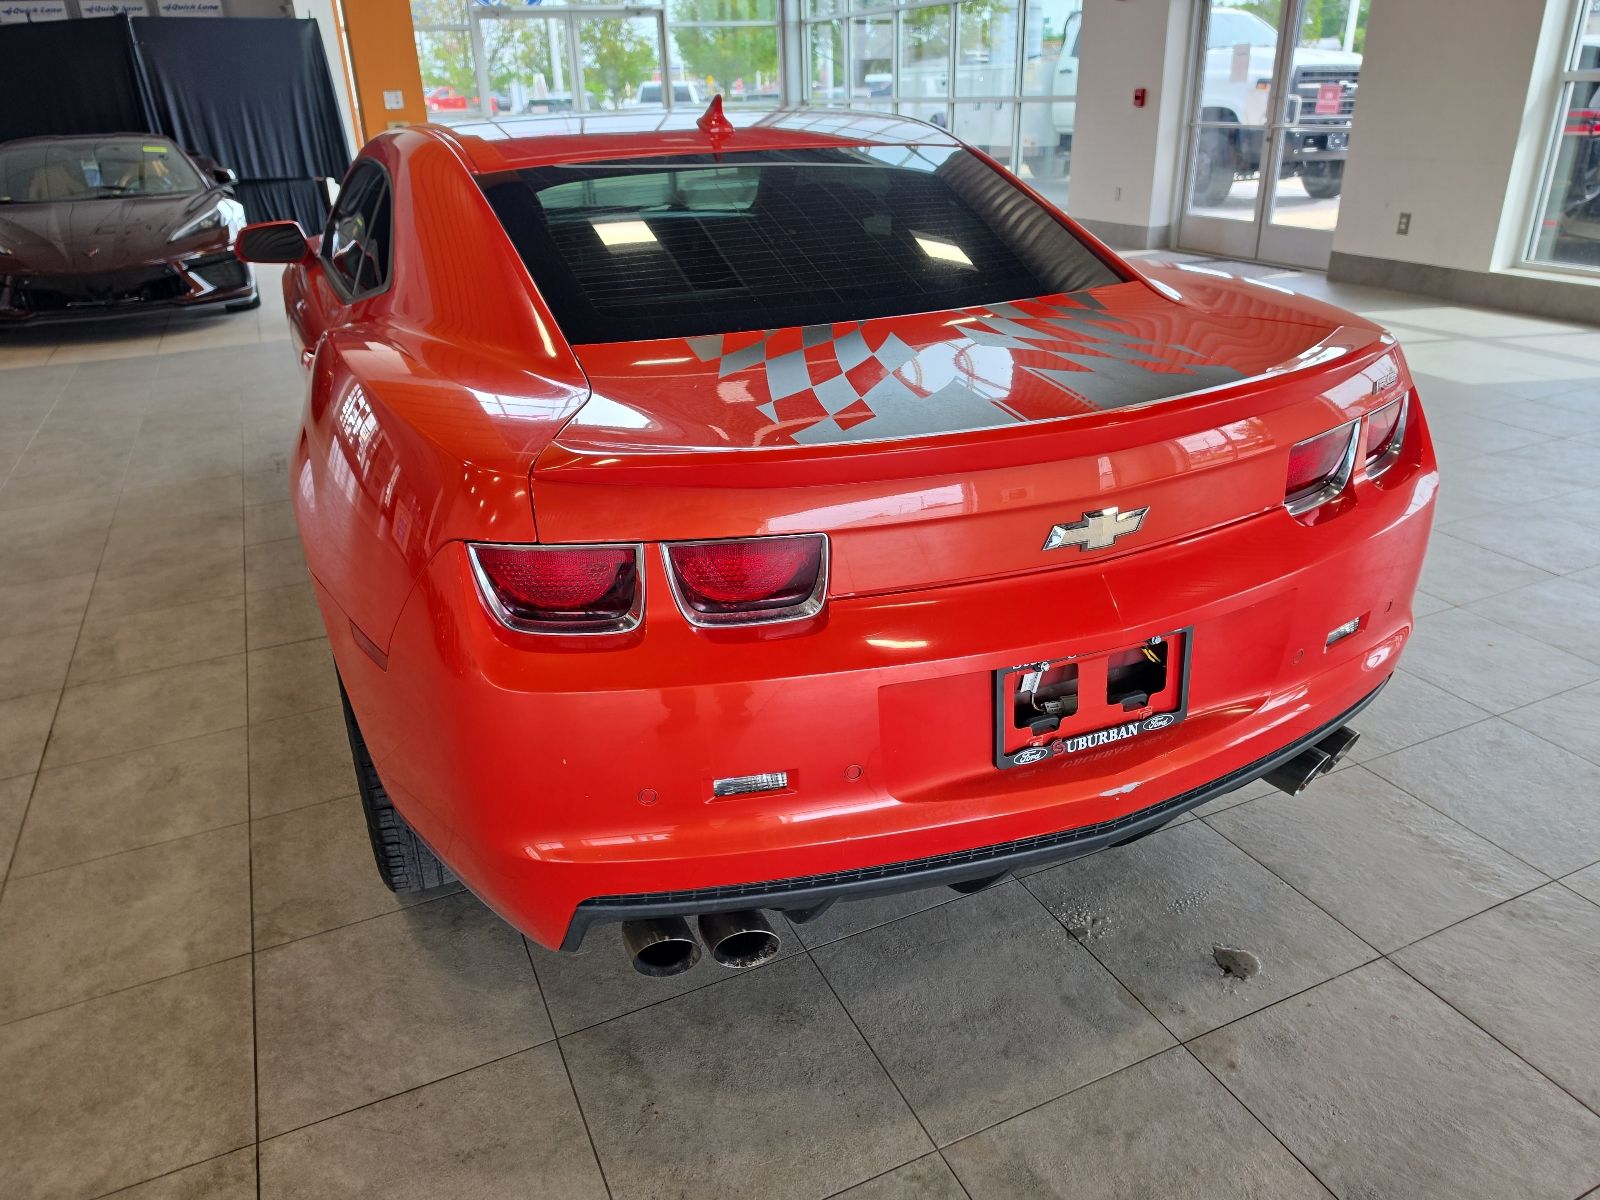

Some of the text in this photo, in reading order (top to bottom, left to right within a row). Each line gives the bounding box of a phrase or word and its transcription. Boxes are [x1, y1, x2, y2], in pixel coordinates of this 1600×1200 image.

[1018, 715, 1171, 763] Ford SUBURBAN Ford
